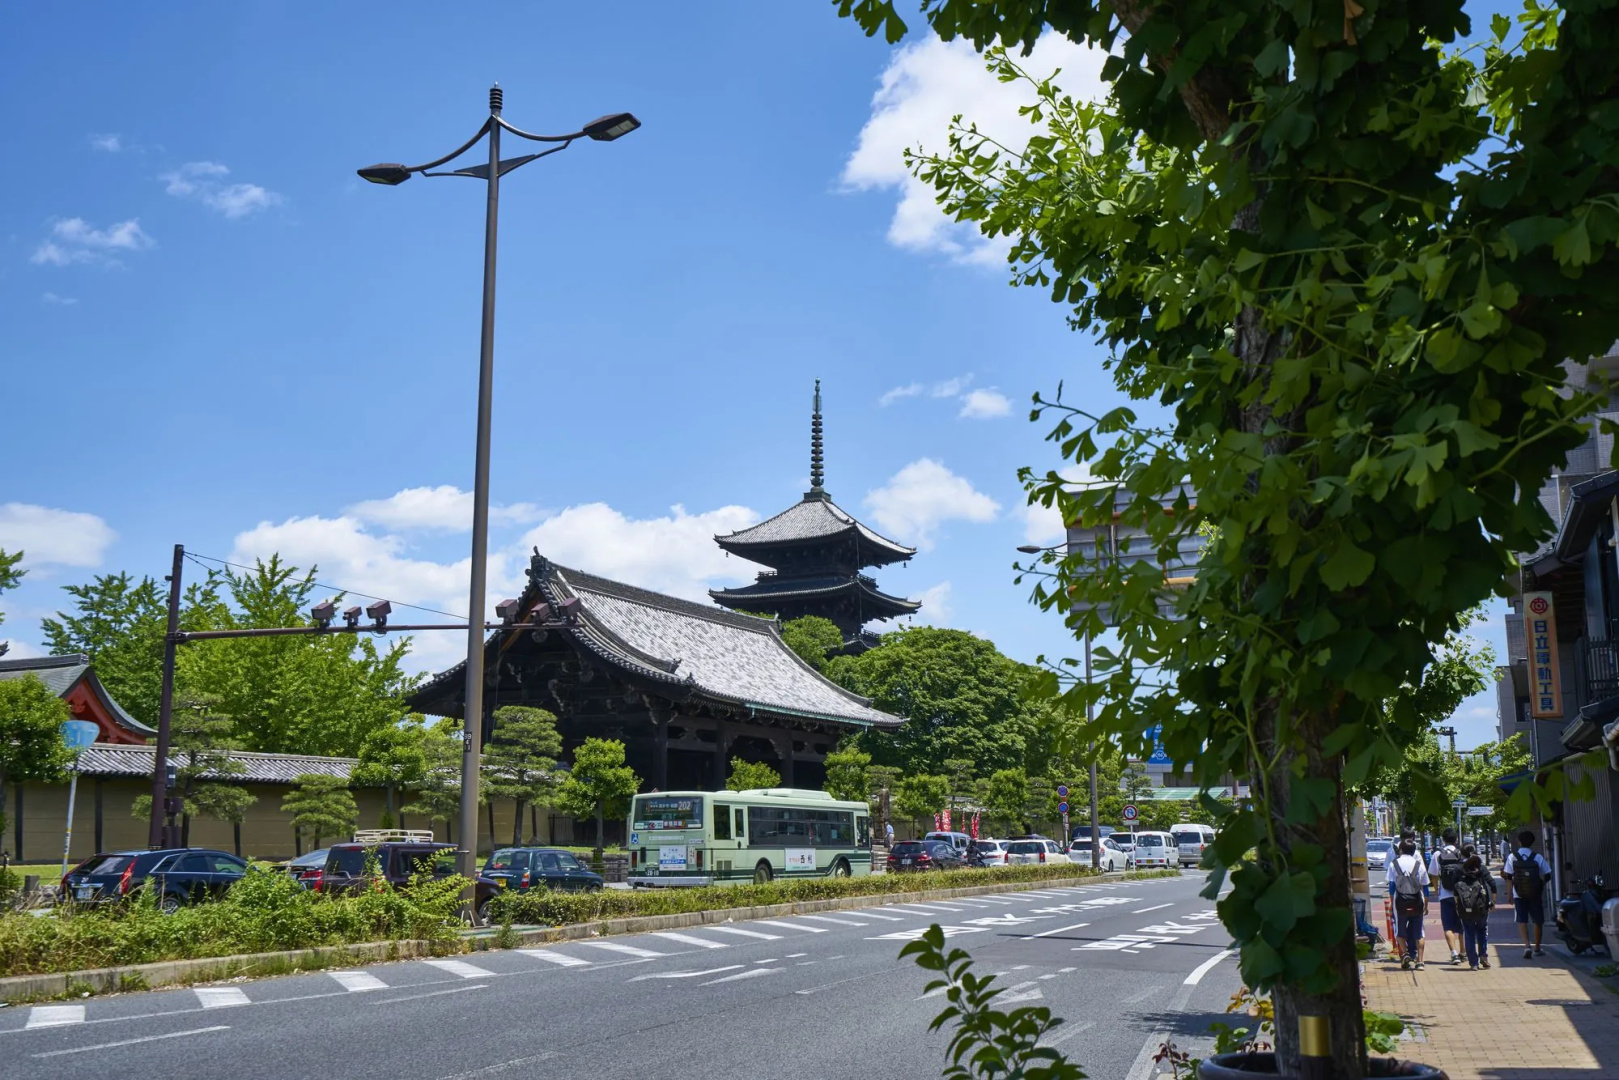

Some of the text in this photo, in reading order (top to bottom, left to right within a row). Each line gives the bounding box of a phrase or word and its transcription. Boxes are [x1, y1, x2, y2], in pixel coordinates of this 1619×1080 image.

[1534, 620, 1554, 711] 日立電動工具
[678, 800, 692, 811] 202
